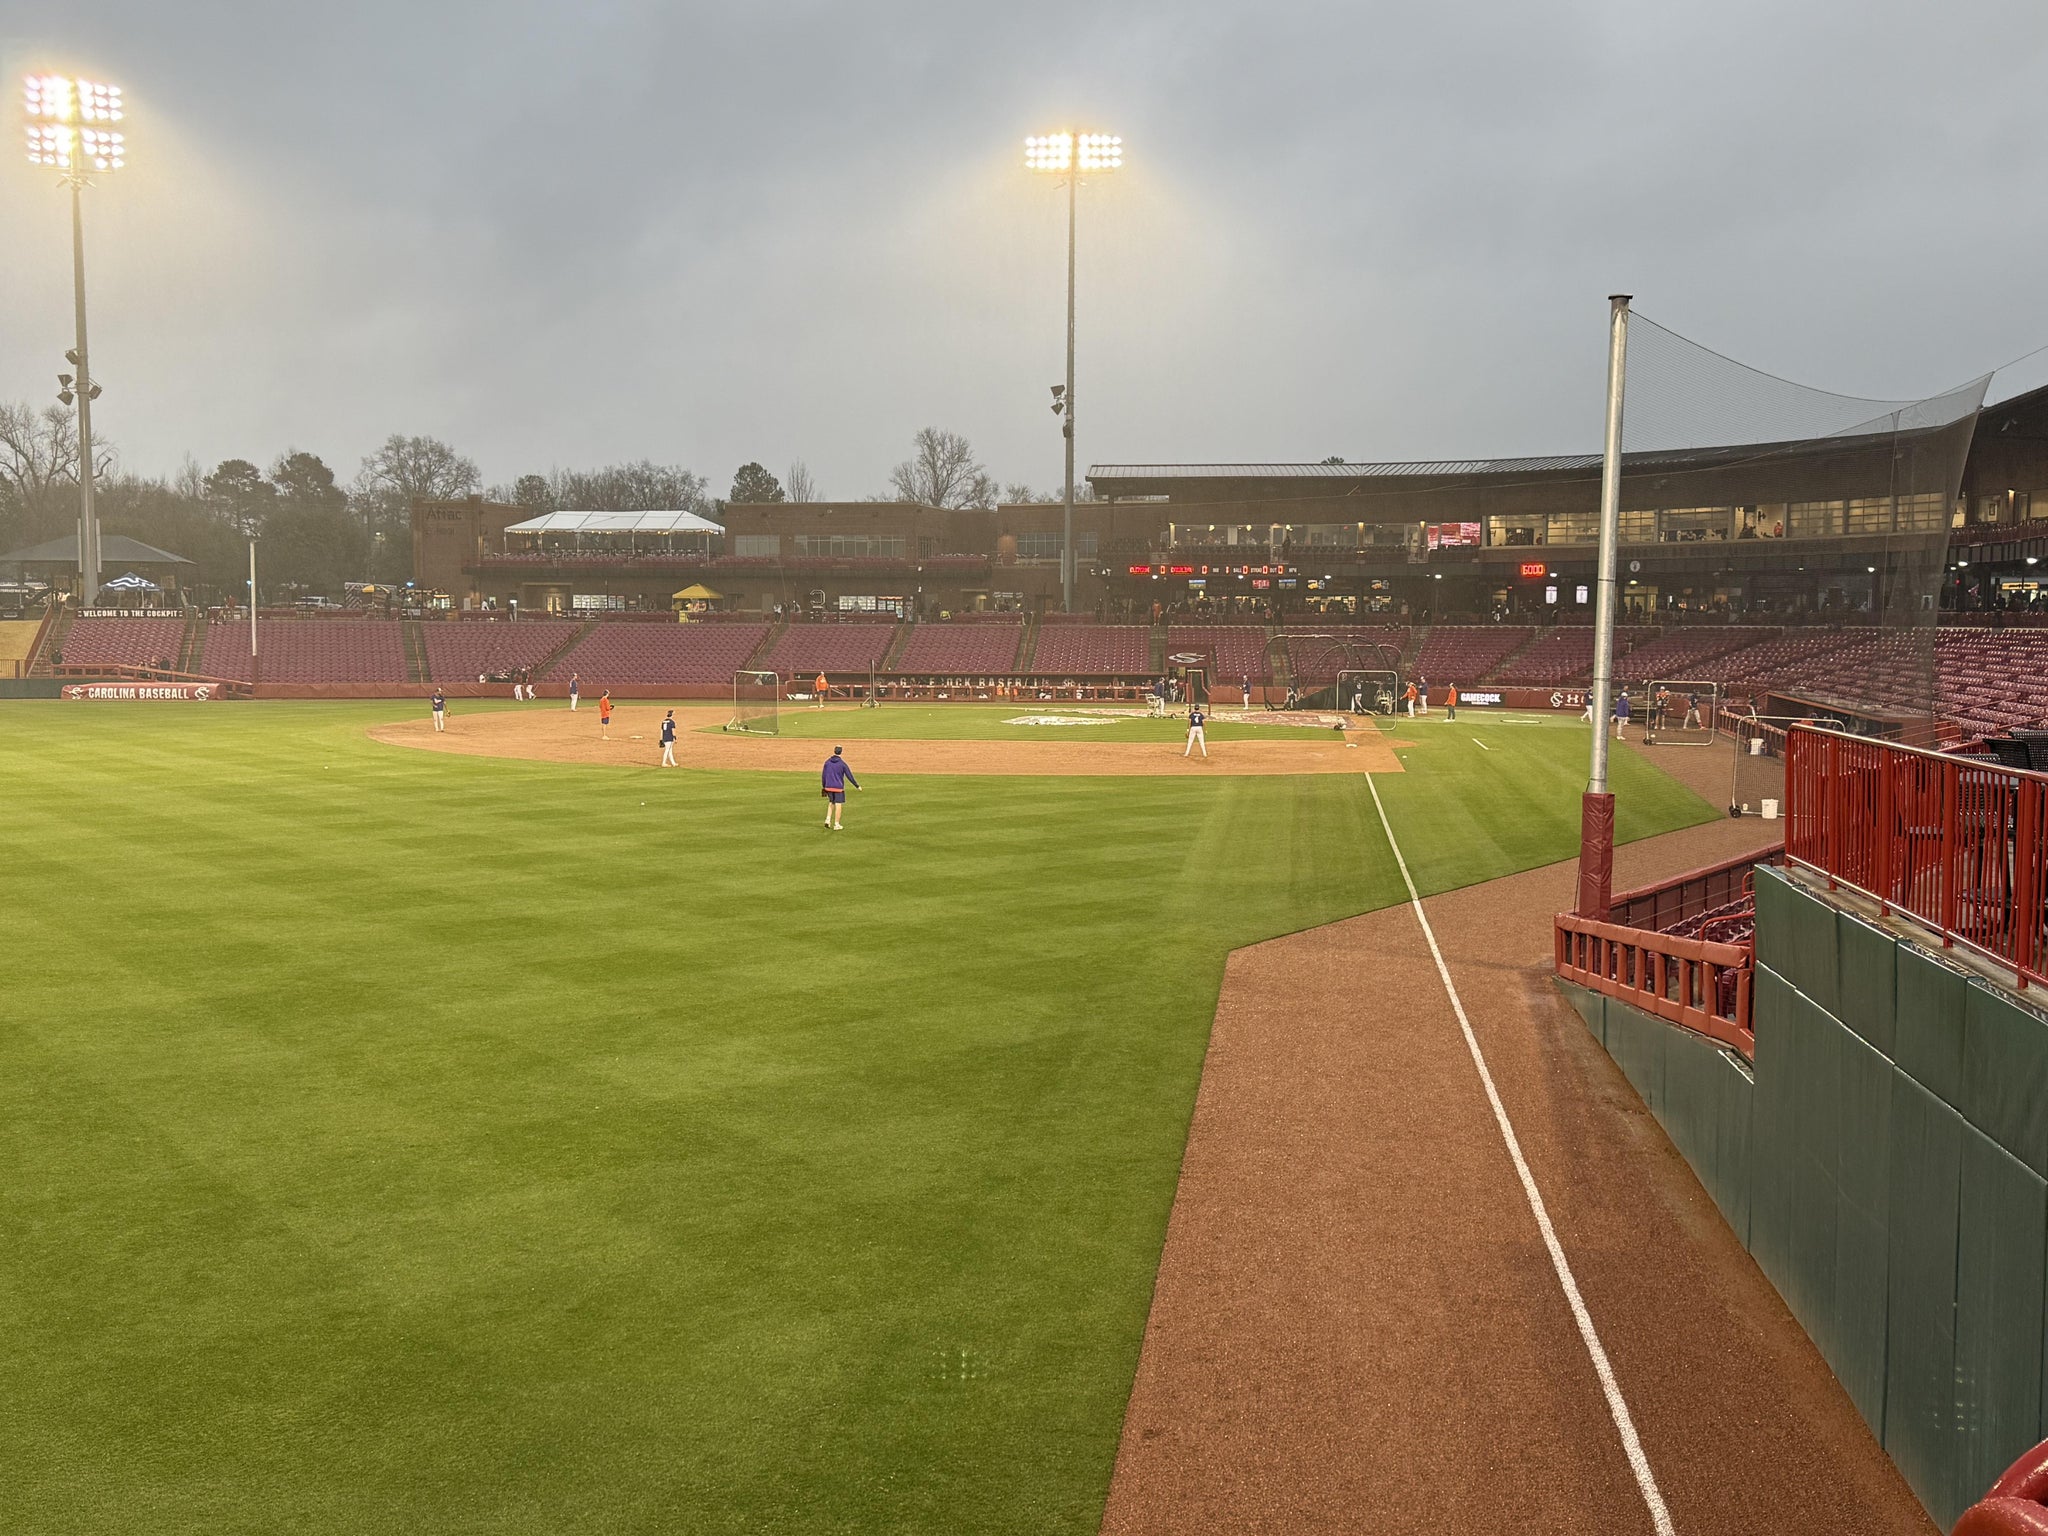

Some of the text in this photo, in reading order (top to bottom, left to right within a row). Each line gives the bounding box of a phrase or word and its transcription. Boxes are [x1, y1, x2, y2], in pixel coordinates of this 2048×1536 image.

[88, 687, 189, 699] CAROLINA BASEBALL
[1460, 692, 1502, 703] GAMECOCK
